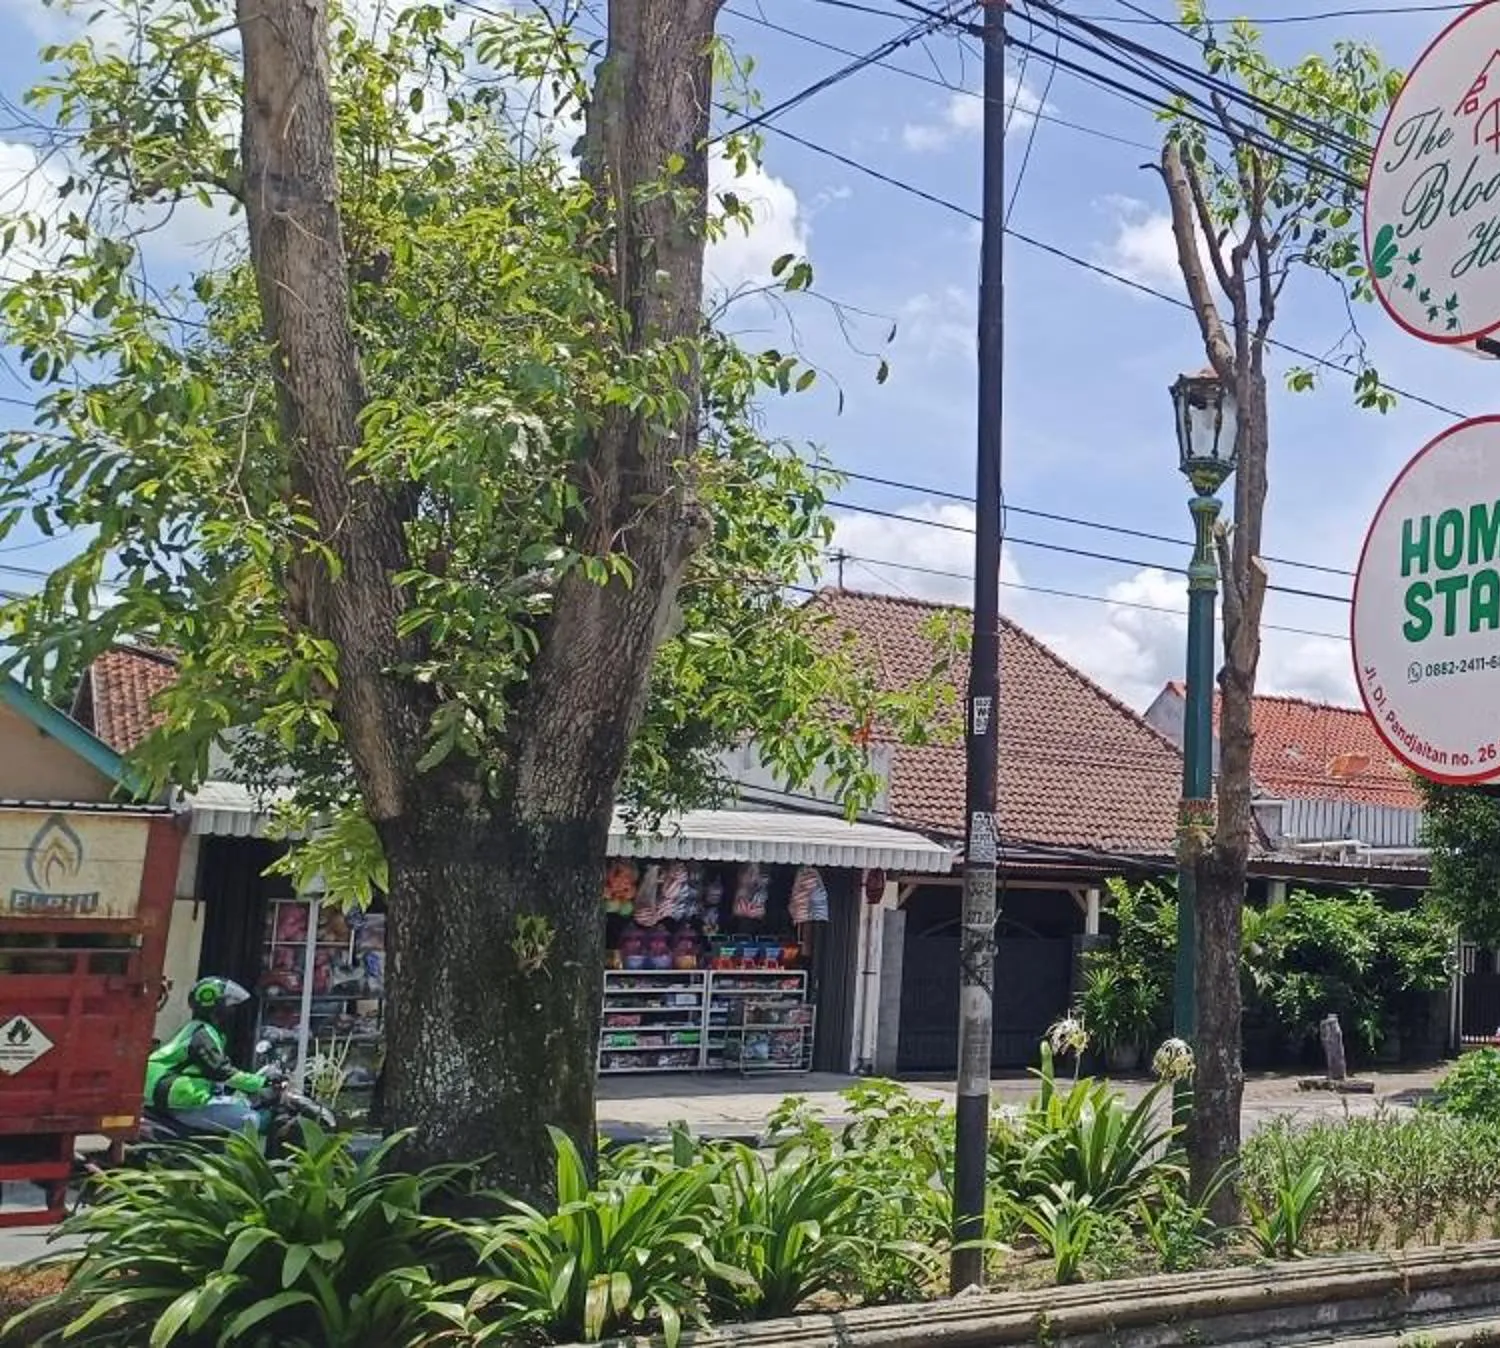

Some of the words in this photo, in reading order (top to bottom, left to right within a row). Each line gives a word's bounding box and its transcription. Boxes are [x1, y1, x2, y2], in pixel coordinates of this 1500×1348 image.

[1384, 106, 1454, 172] The
[1385, 710, 1448, 766] Pandjaitan
[1451, 753, 1474, 767] no.
[1478, 743, 1497, 763] 26
